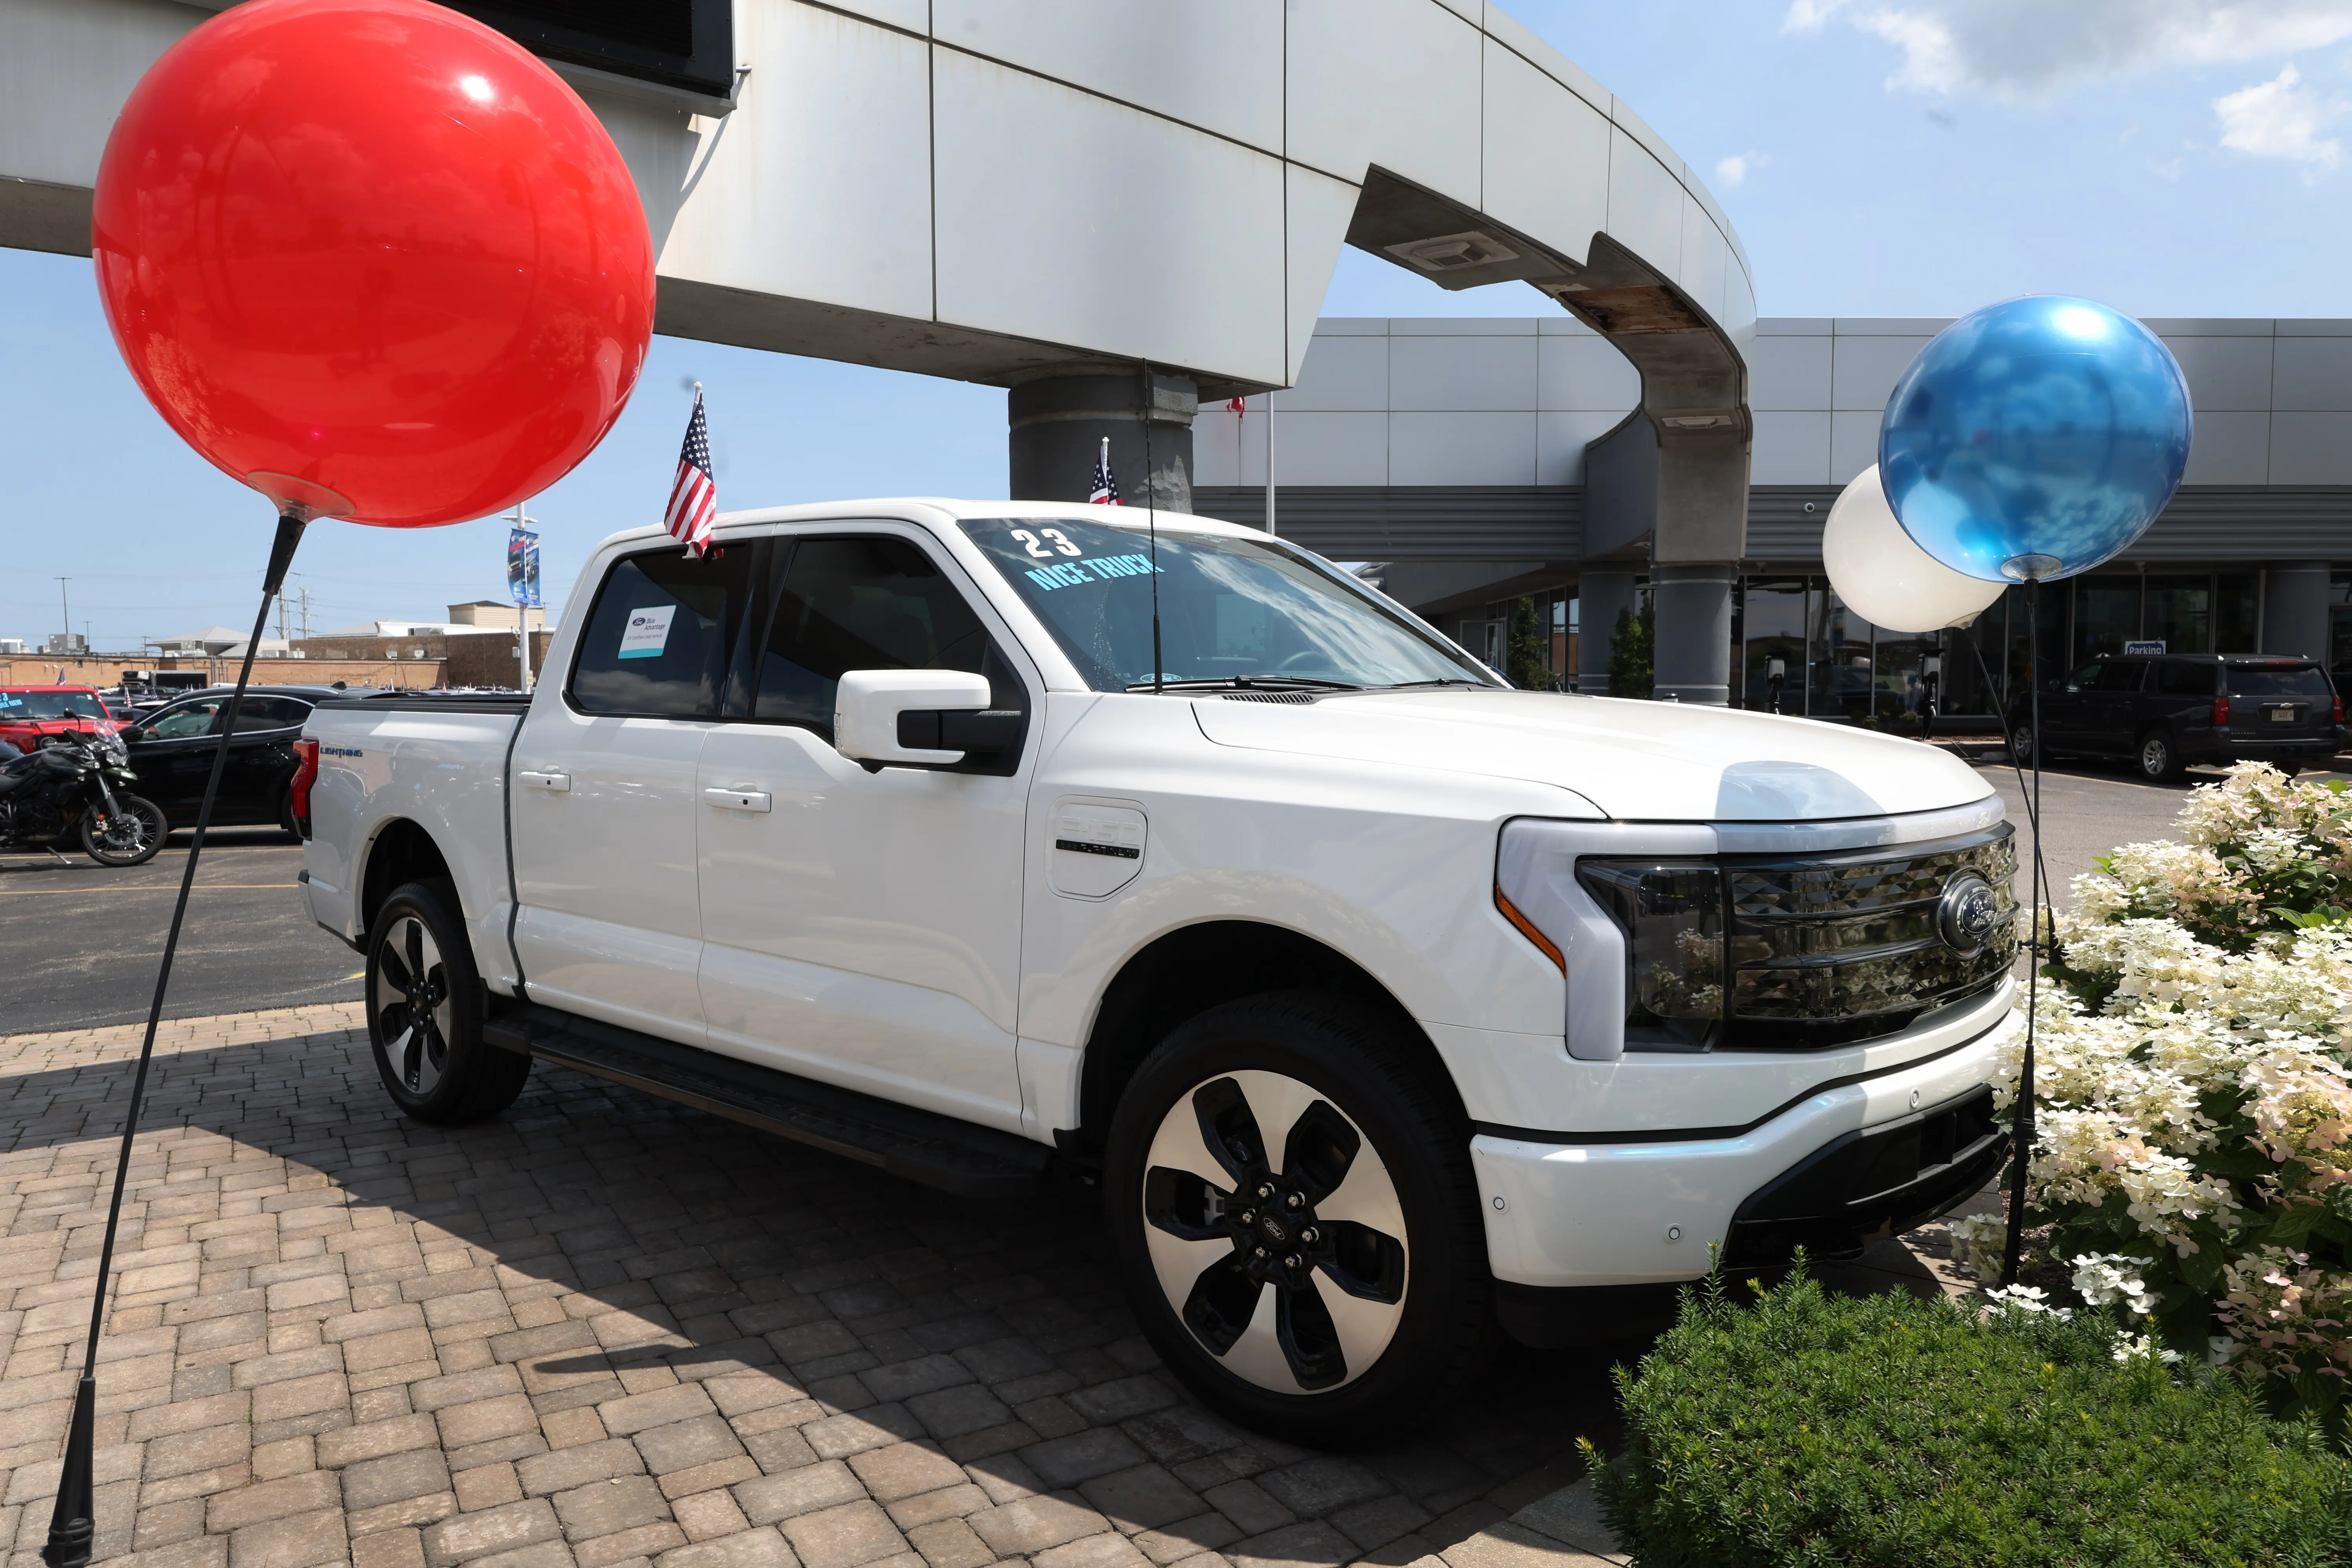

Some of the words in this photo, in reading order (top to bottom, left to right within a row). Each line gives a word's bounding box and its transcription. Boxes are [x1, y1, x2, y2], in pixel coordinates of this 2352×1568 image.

[1011, 528, 1082, 558] 23
[1024, 562, 1095, 591] NICE
[1080, 554, 1165, 579] TRUCK
[320, 746, 363, 759] LIGHTNING
[1057, 816, 1143, 846] F-150
[1080, 843, 1135, 857] PLATINUM
[1971, 899, 1995, 928] Ford
[1266, 1221, 1282, 1236] Ford
